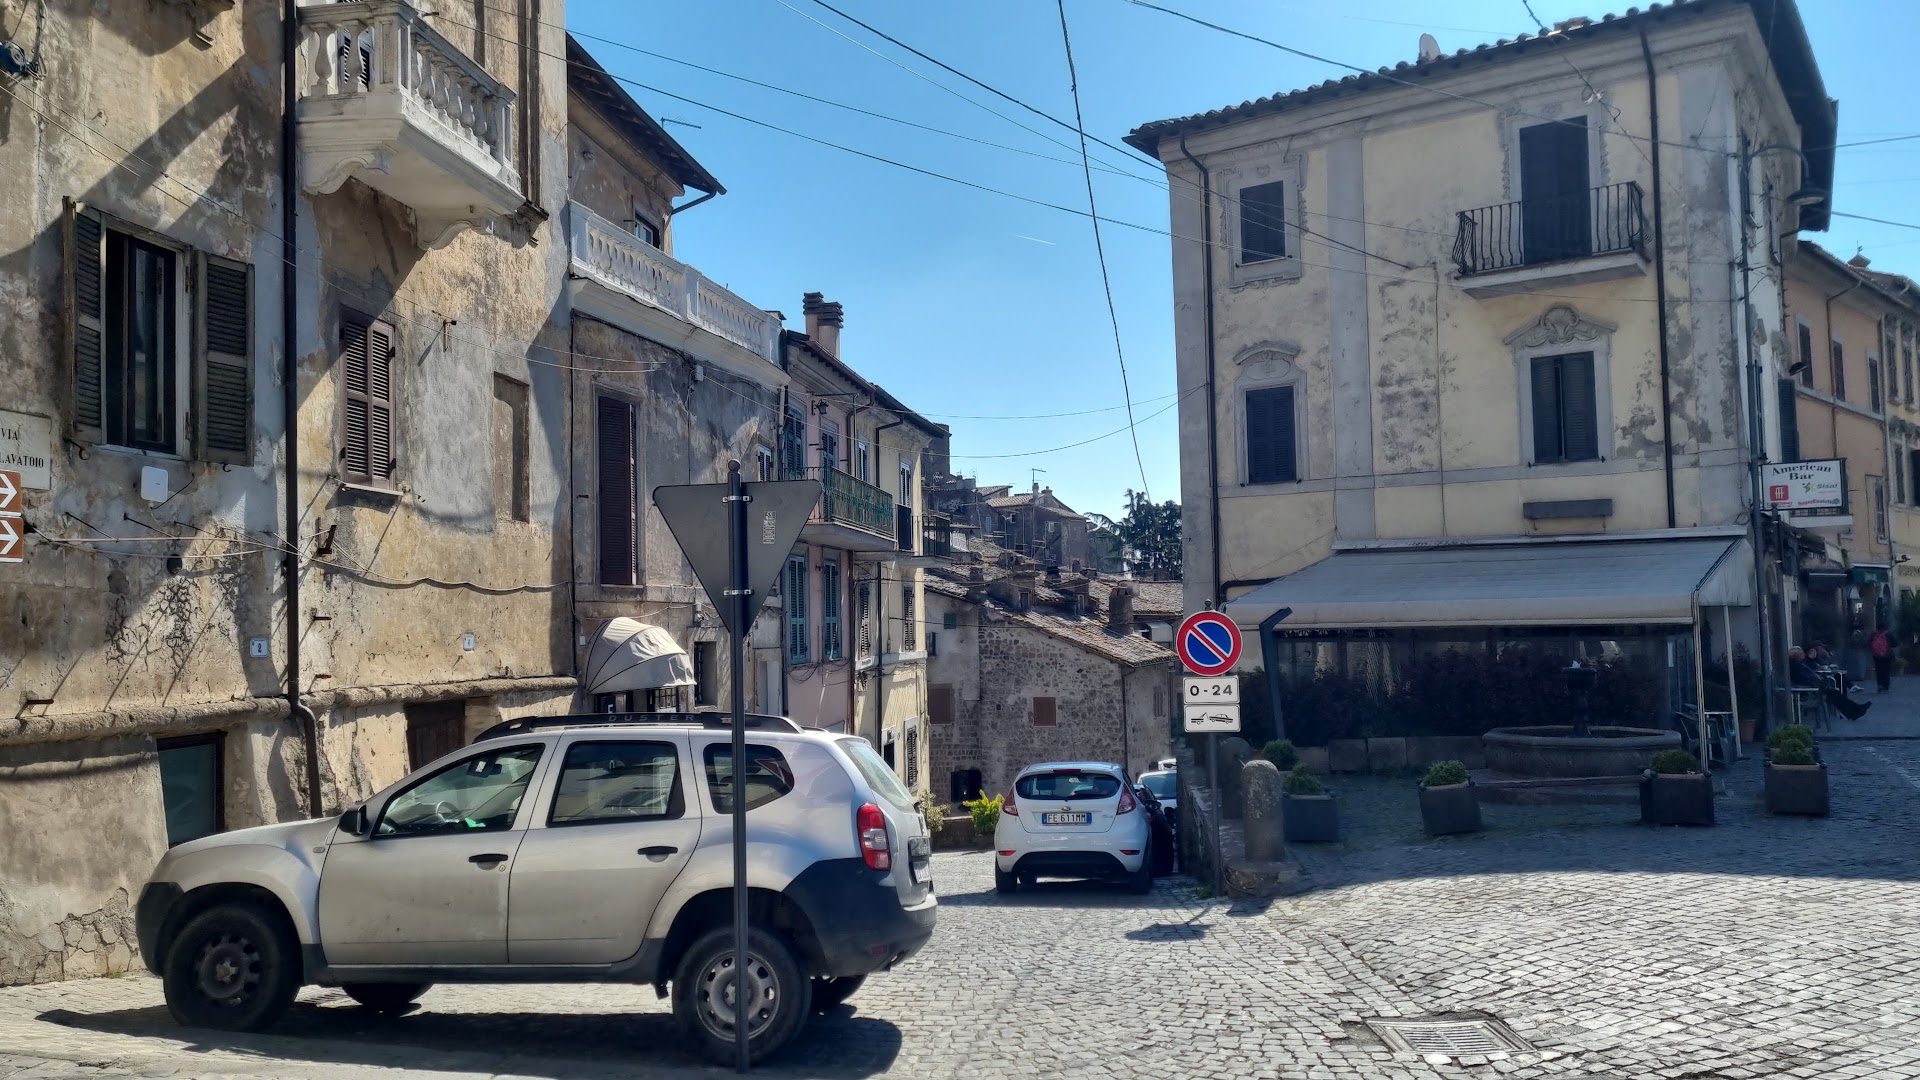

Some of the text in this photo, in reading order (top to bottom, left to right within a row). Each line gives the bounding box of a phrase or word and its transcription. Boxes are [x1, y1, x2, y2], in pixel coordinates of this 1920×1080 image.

[1, 428, 18, 441] VIA
[1772, 462, 1832, 476] American
[1789, 472, 1815, 481] Bar
[1212, 684, 1233, 696] 24
[608, 714, 695, 722] DUSTER
